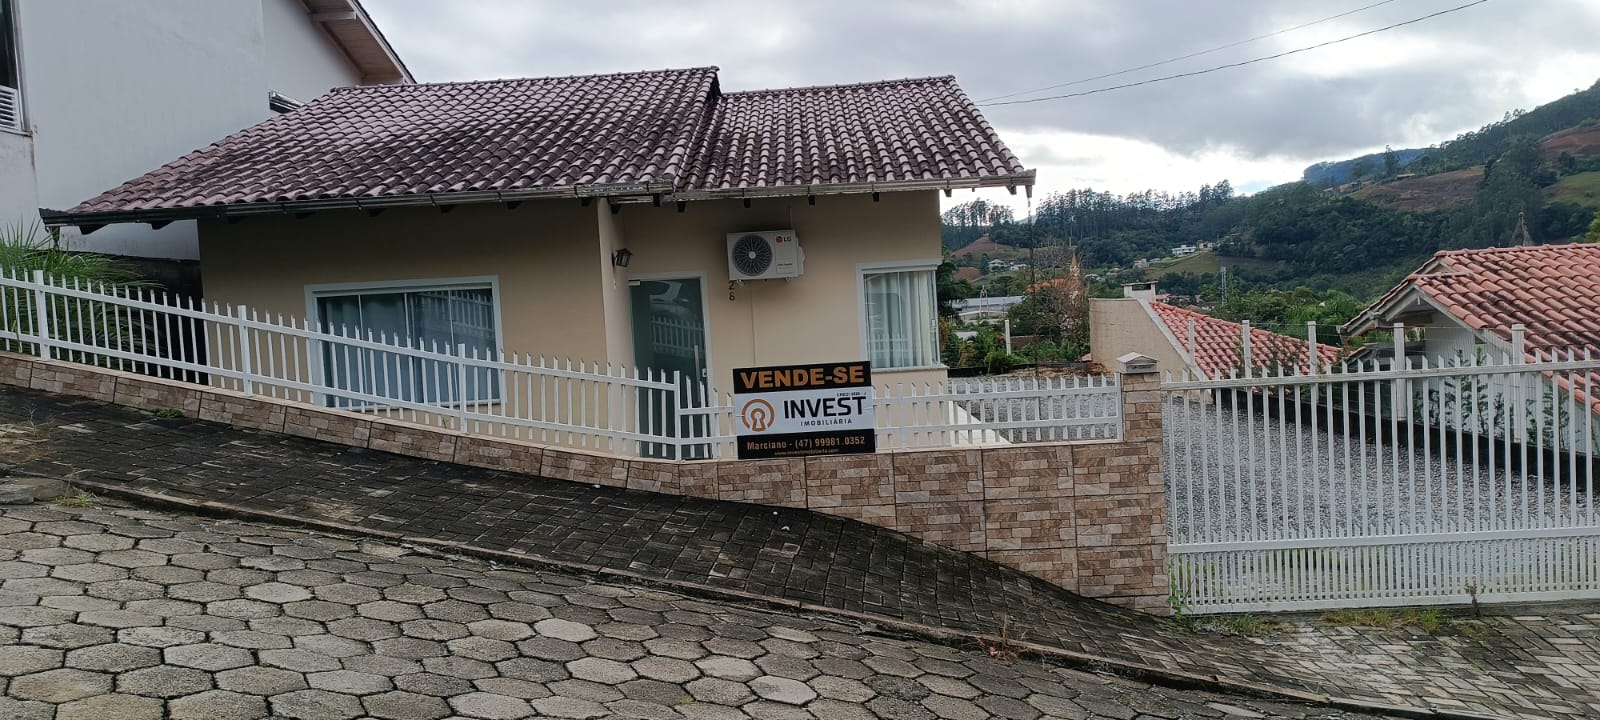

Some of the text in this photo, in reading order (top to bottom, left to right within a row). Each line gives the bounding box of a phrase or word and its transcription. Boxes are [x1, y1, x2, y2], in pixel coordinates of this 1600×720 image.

[740, 365, 865, 389] VENDE-SE
[783, 396, 867, 419] INVEST
[800, 418, 853, 427] IMOBILIÁRIA
[746, 441, 787, 451] Marciano
[795, 439, 813, 450] (47)
